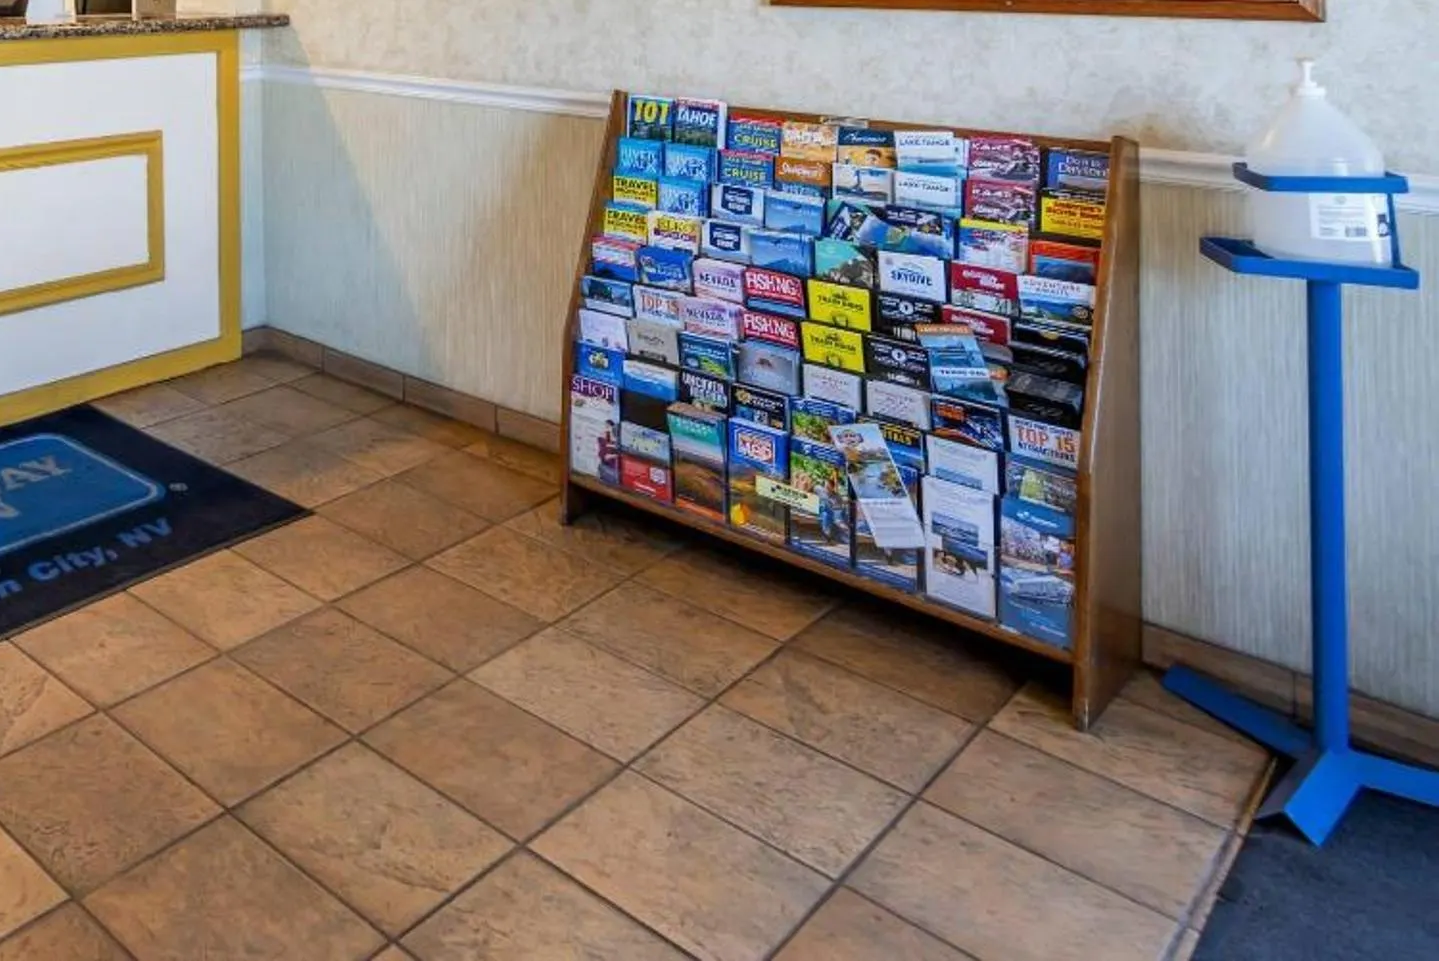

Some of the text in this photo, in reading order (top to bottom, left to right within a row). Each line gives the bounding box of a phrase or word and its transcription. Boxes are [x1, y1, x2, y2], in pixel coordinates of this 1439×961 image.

[635, 100, 669, 125] 101
[677, 107, 717, 126] TAHOE
[734, 134, 778, 148] CRUISE
[724, 167, 766, 181] CRUISE
[615, 178, 655, 192] TRAVEL
[891, 270, 933, 286] SKYDIVE
[641, 293, 662, 313] TOP
[572, 376, 616, 401] SHOP
[1016, 425, 1049, 446] TOP
[1055, 435, 1076, 453] 15
[27, 543, 119, 583] City,
[122, 517, 174, 549] NV
